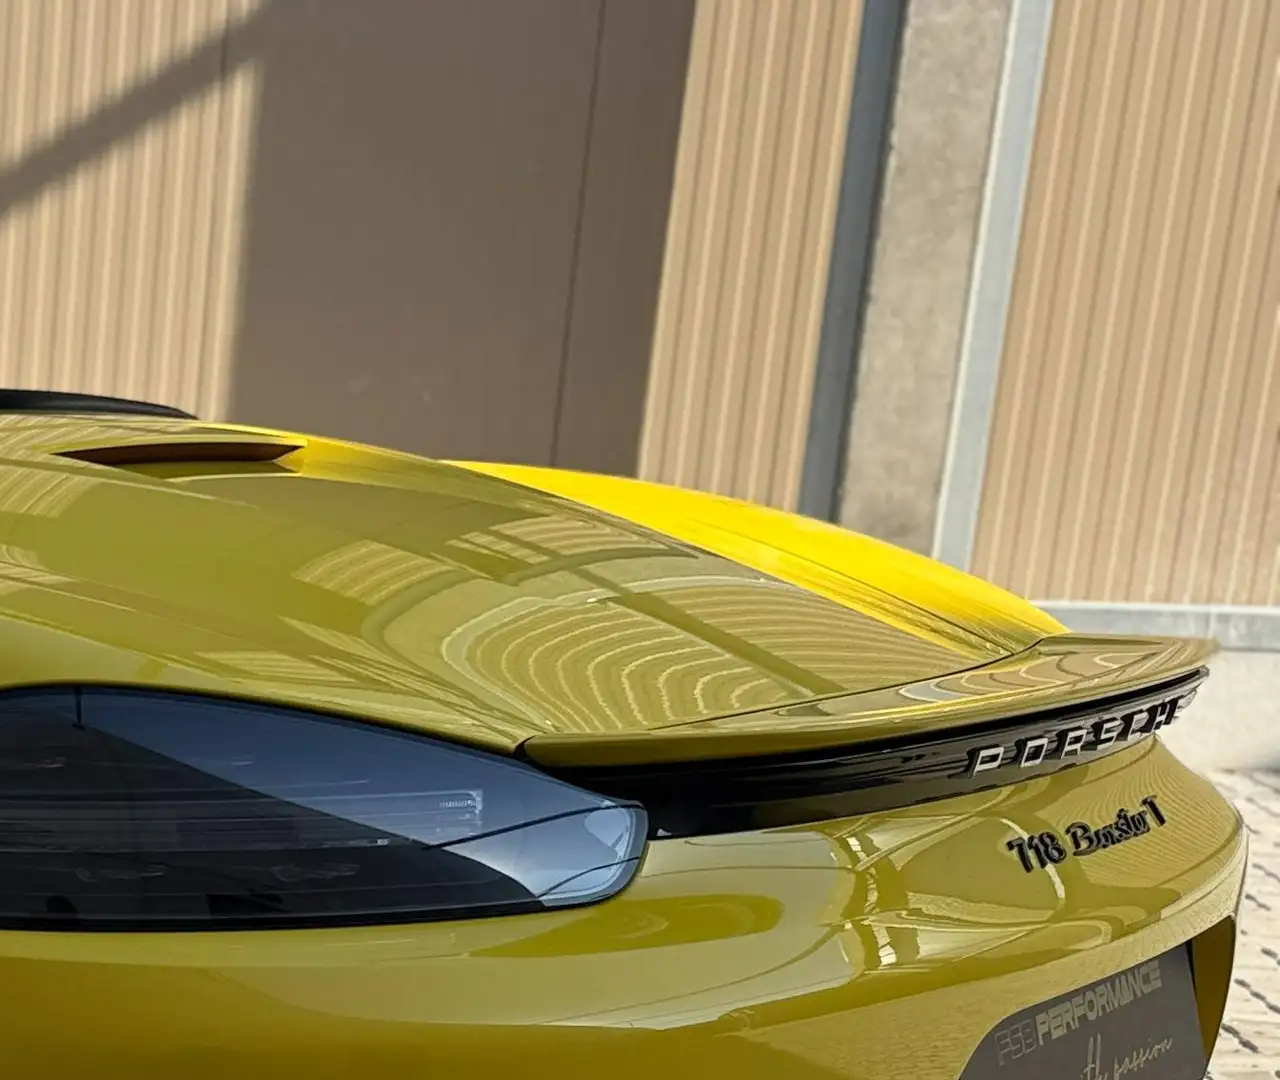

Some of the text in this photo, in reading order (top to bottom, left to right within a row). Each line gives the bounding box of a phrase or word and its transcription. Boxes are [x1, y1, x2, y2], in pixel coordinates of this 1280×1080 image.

[1006, 831, 1067, 873] 718
[1140, 794, 1167, 828] T
[1036, 958, 1163, 1047] PERFORMANCE
